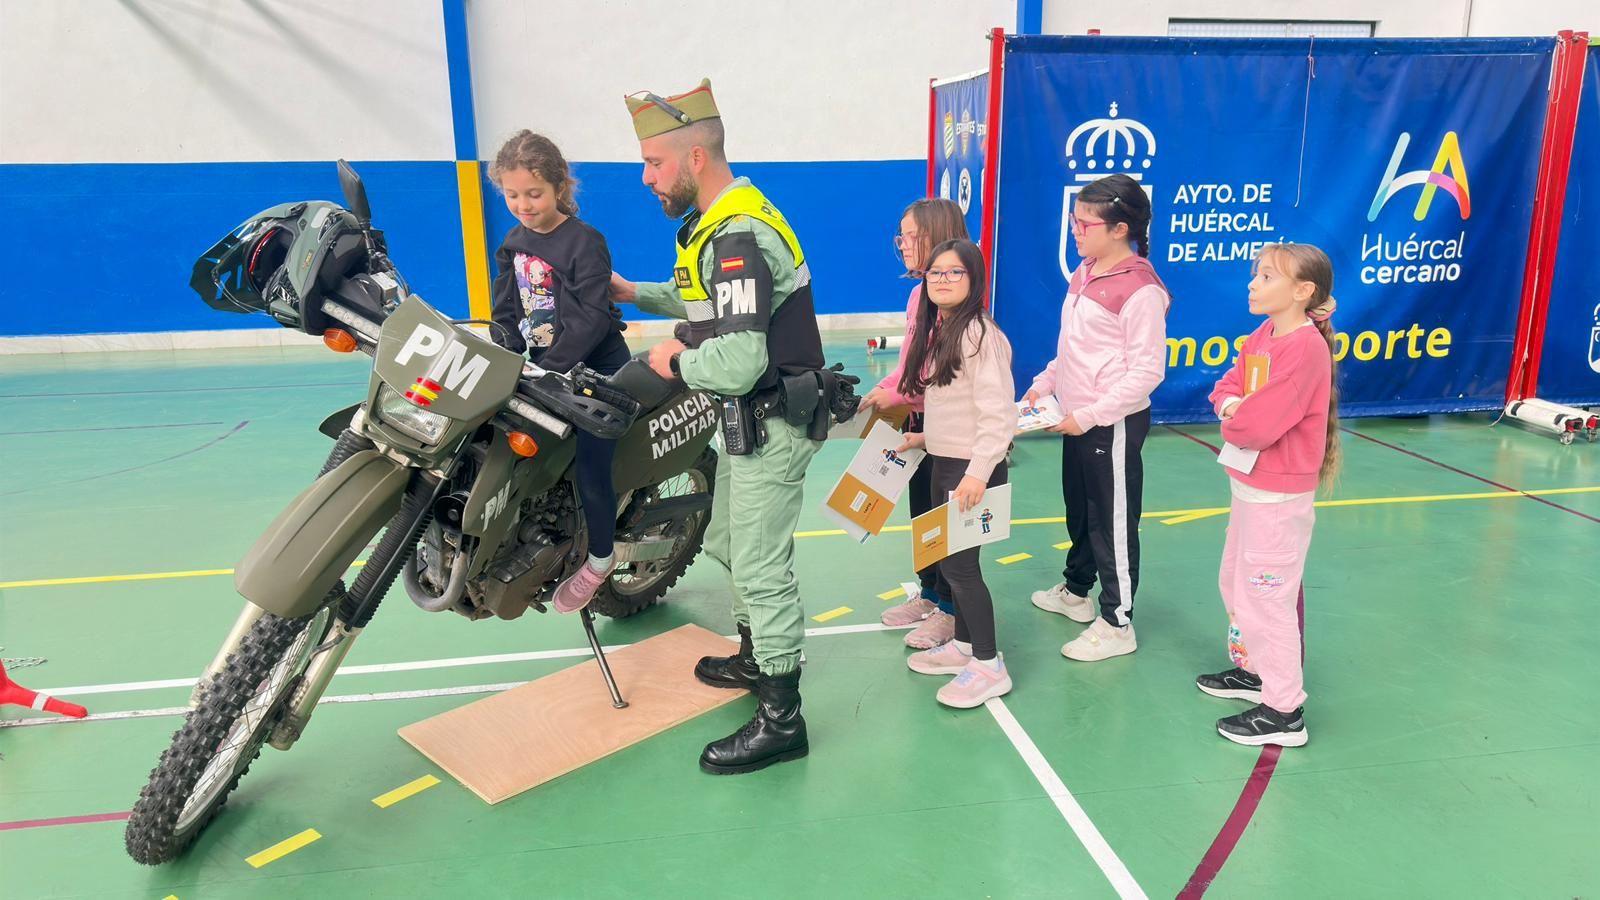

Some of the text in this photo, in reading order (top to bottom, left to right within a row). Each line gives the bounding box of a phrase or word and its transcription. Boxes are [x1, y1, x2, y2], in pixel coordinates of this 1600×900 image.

[1173, 183, 1272, 204] AYTO. DE
[1170, 208, 1275, 233] HUÉRCAL
[1167, 243, 1199, 262] DE
[1361, 230, 1465, 261] Huércal
[1360, 262, 1461, 284] cercano
[715, 278, 757, 319] PM
[394, 323, 490, 400] PM
[648, 392, 711, 438] POLICIA
[651, 408, 716, 460] MILITAR
[481, 480, 511, 532] PM
